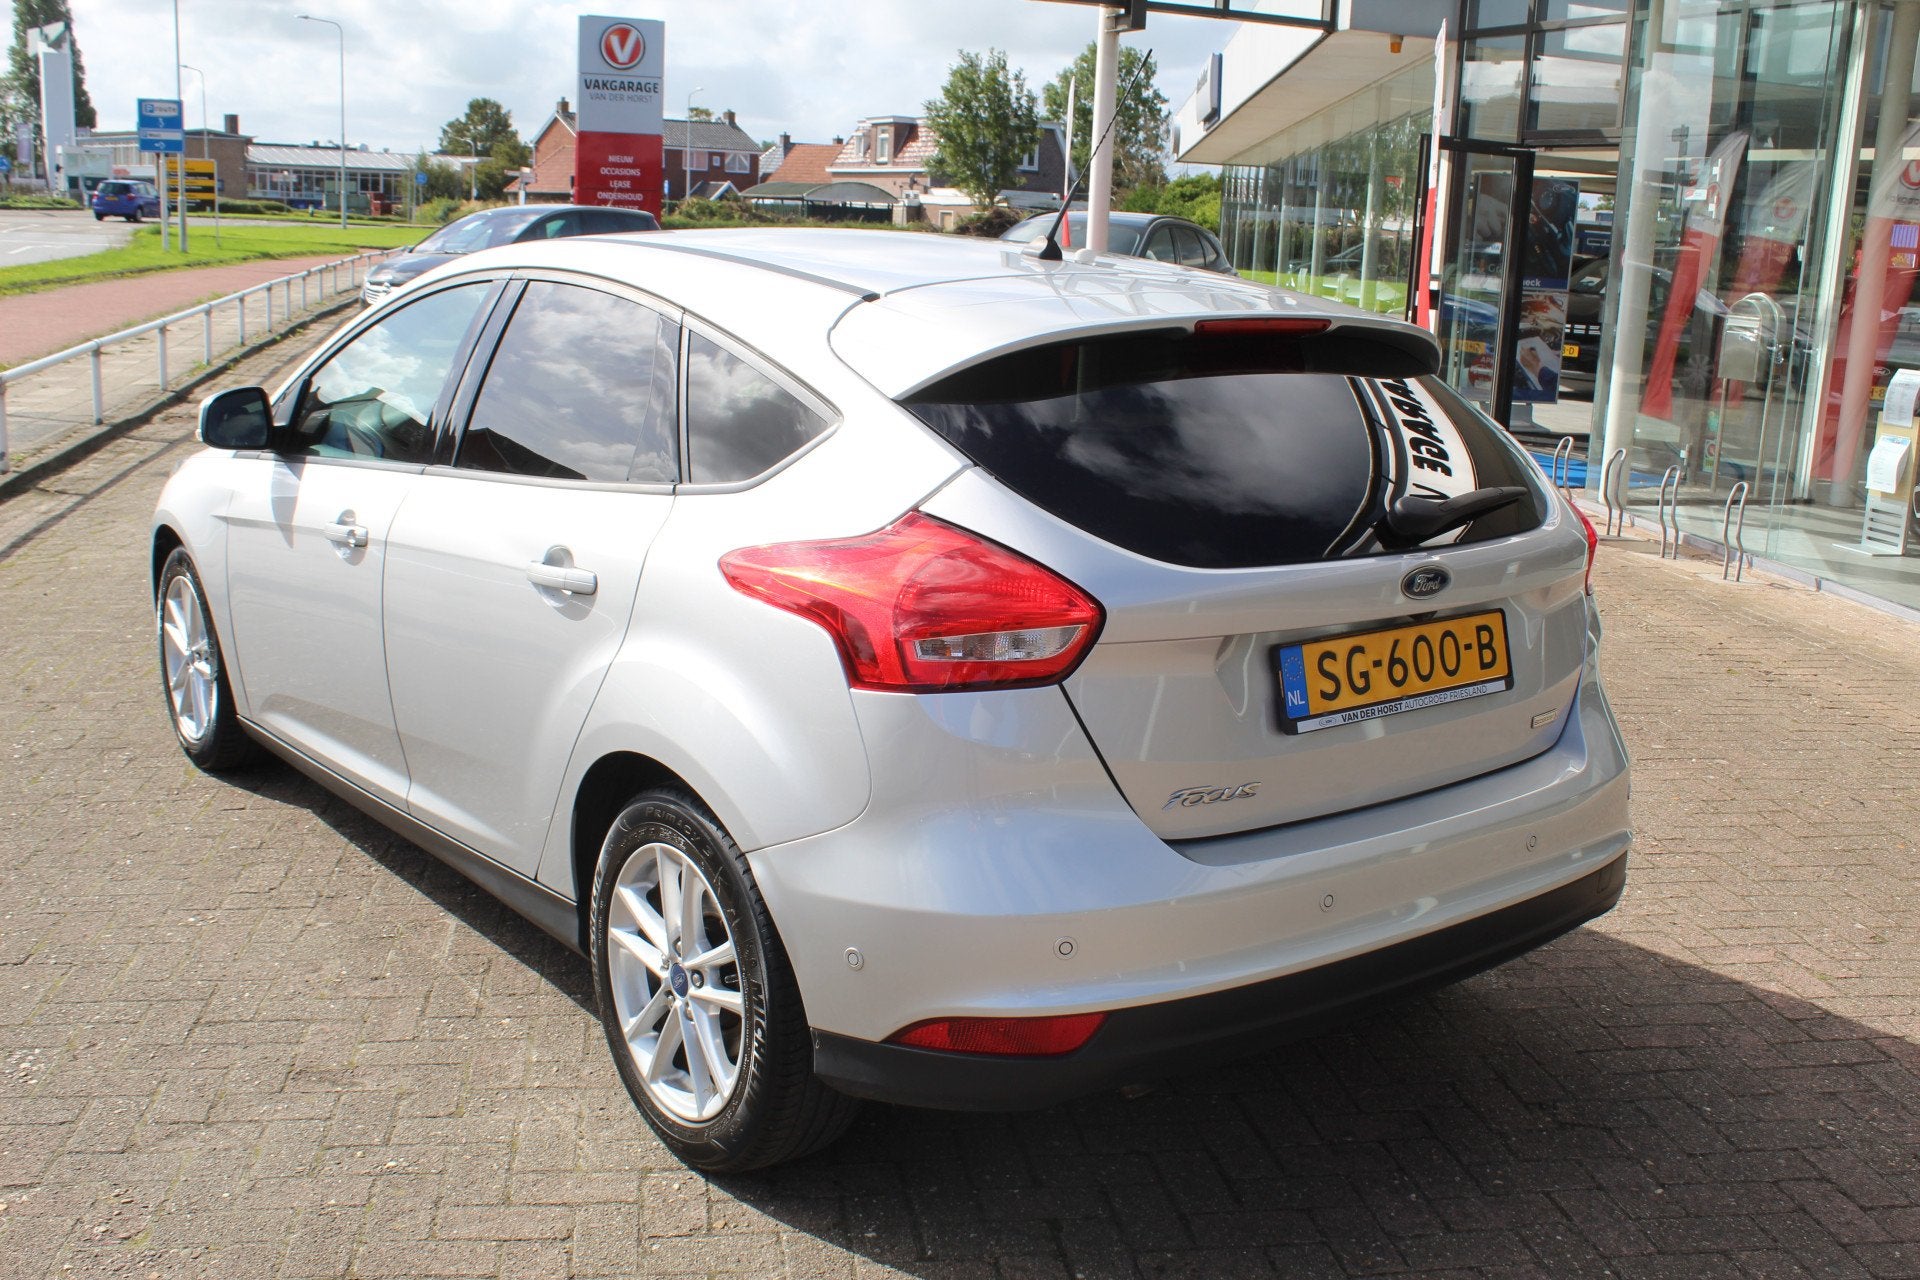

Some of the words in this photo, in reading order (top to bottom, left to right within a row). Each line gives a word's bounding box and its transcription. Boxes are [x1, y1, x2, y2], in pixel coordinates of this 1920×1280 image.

[584, 78, 660, 94] VAKGARAGE
[589, 92, 607, 101] VAN
[609, 93, 625, 102] DER
[627, 94, 653, 103] HORST
[608, 155, 634, 163] NIEUW
[600, 167, 642, 176] OCCASIONS
[609, 180, 632, 189] LEASE
[597, 191, 644, 201] ONDERHOUD
[1413, 573, 1441, 592] Ford
[1317, 624, 1497, 702] SG-600-B
[1288, 690, 1305, 707] NL
[1341, 713, 1359, 723] VAN
[1360, 708, 1376, 719] DER
[1377, 702, 1403, 714] HORST
[1404, 693, 1449, 710] AUTOGROEP
[1449, 685, 1488, 701] FRIESLAND
